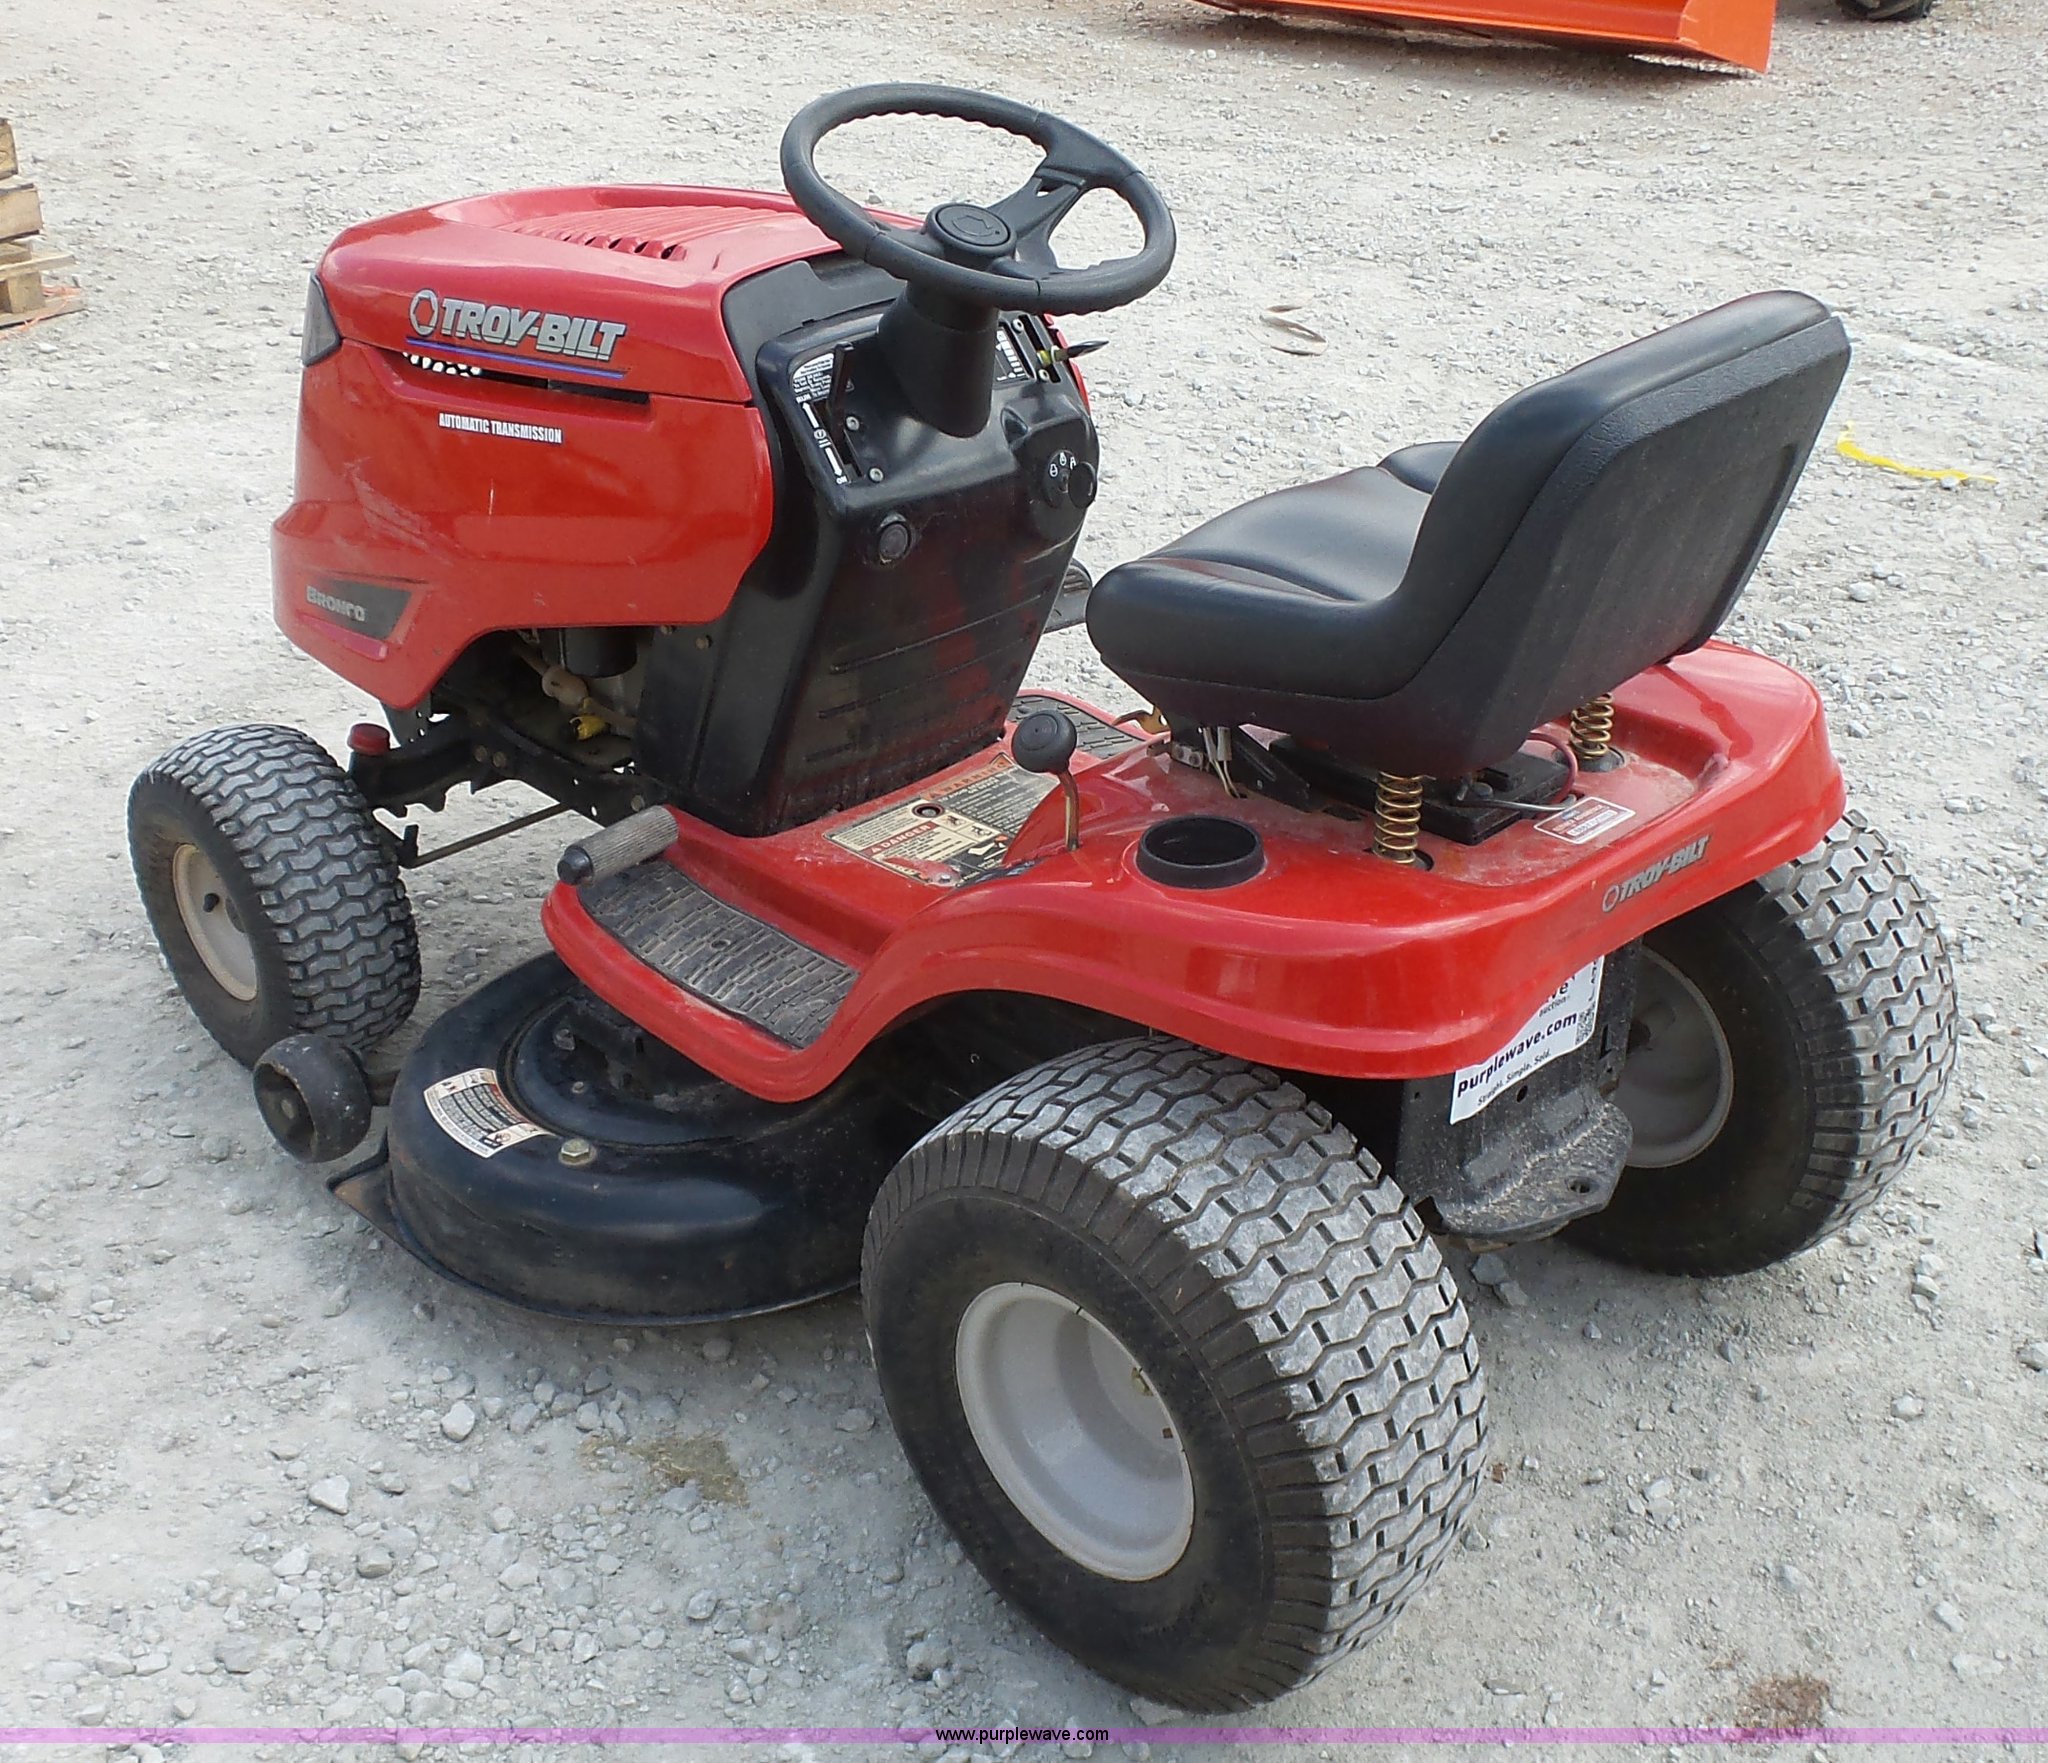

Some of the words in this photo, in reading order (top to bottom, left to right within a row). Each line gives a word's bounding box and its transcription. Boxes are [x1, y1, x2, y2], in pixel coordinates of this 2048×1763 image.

[441, 297, 627, 362] TROY-BILT
[438, 412, 490, 434] AUTOMATIC
[490, 420, 563, 444] TRANSMISSION
[306, 585, 366, 622] BRONCO
[881, 825, 932, 848] DANGER
[1619, 834, 1712, 903] TROY-BILT
[1457, 1012, 1578, 1098] purplewave.com
